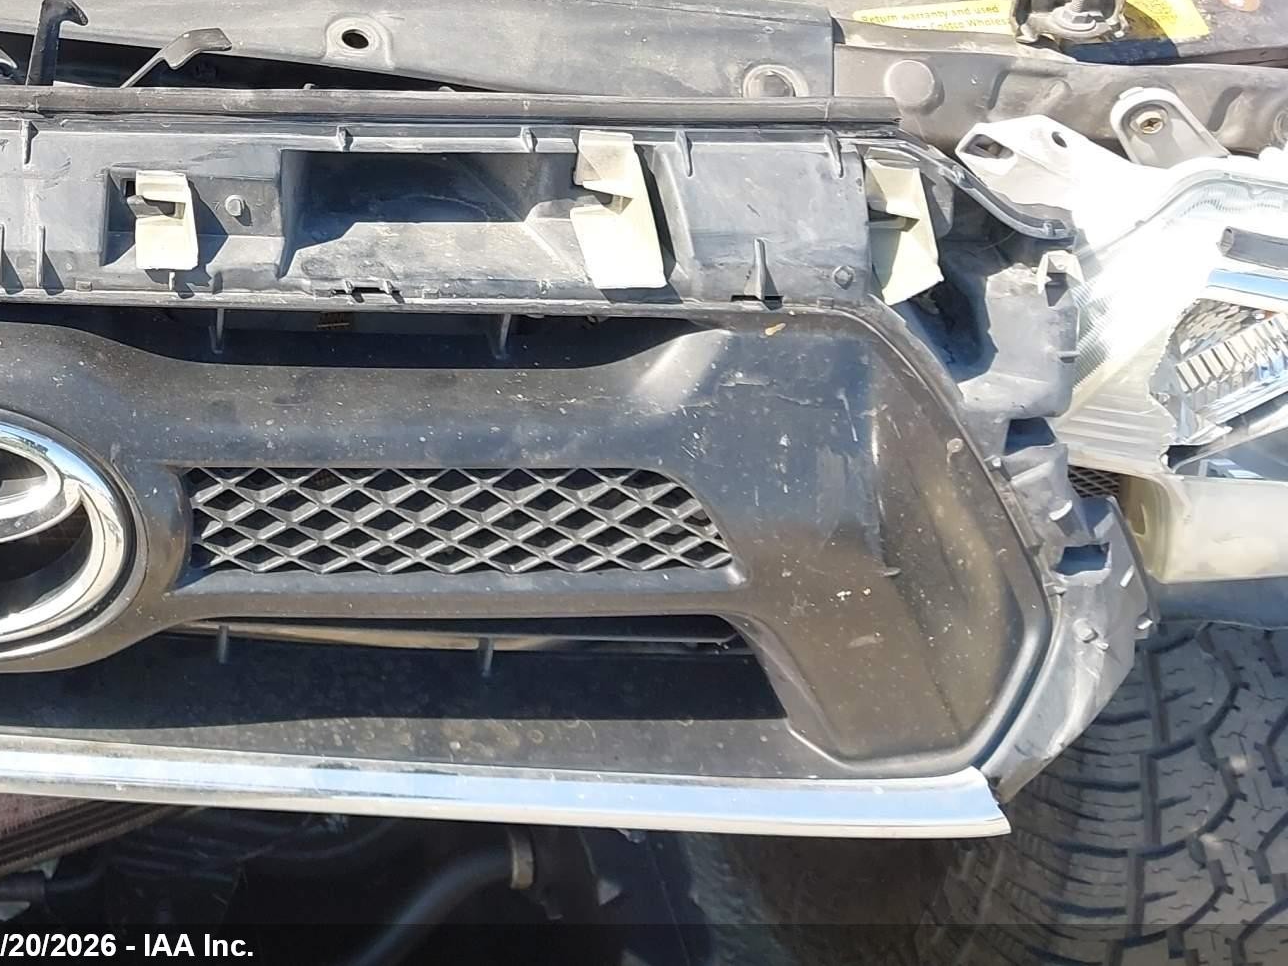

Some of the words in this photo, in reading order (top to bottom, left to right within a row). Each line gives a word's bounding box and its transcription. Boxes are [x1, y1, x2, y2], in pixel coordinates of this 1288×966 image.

[902, 9, 949, 21] warranty
[952, 7, 972, 16] and
[975, 4, 1000, 13] used
